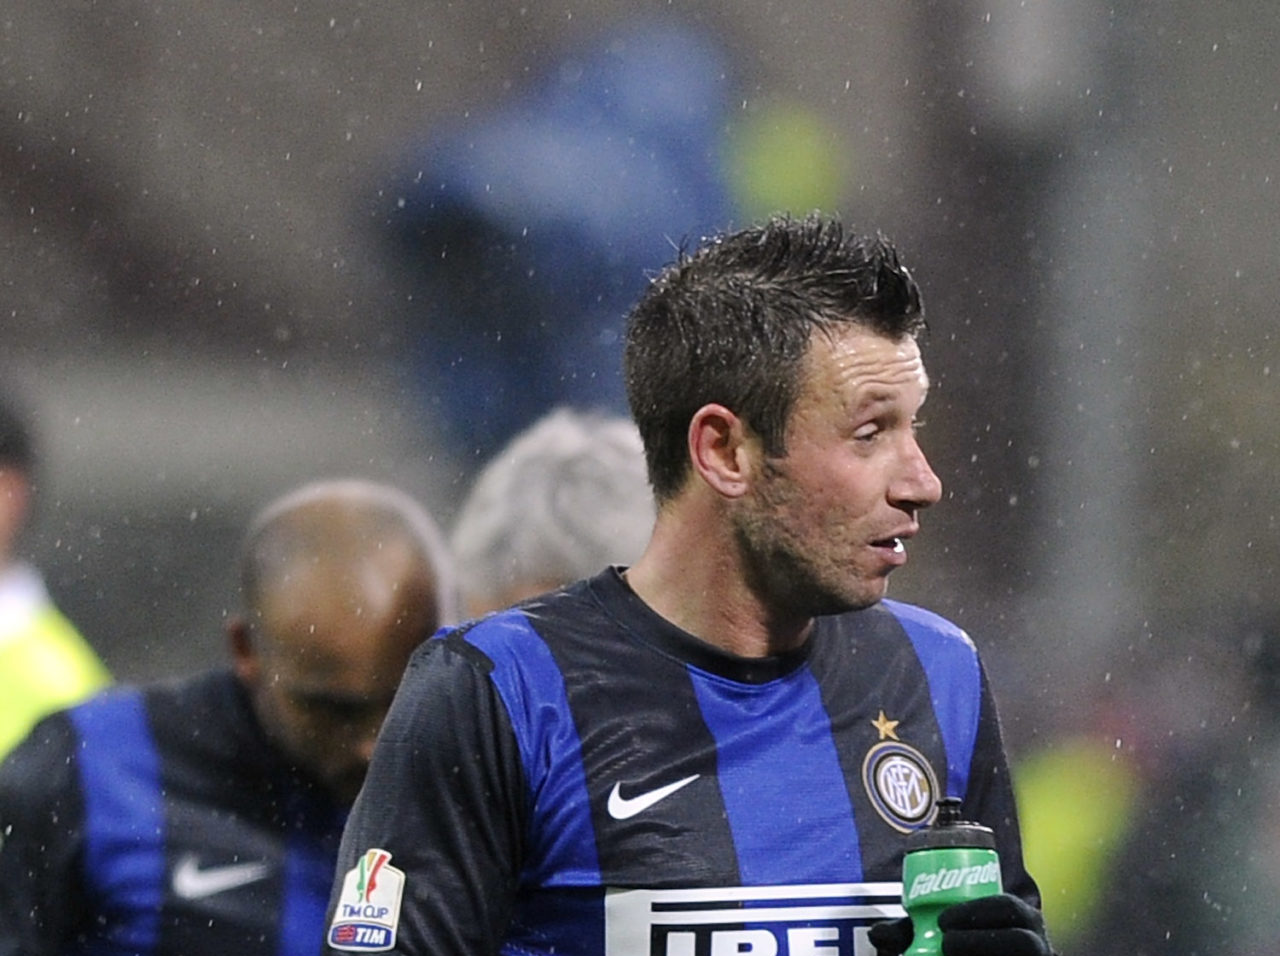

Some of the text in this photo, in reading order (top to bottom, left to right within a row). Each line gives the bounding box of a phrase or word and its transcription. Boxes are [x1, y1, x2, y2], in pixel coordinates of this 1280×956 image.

[342, 903, 389, 919] TIM CUP
[355, 927, 386, 945] TIM
